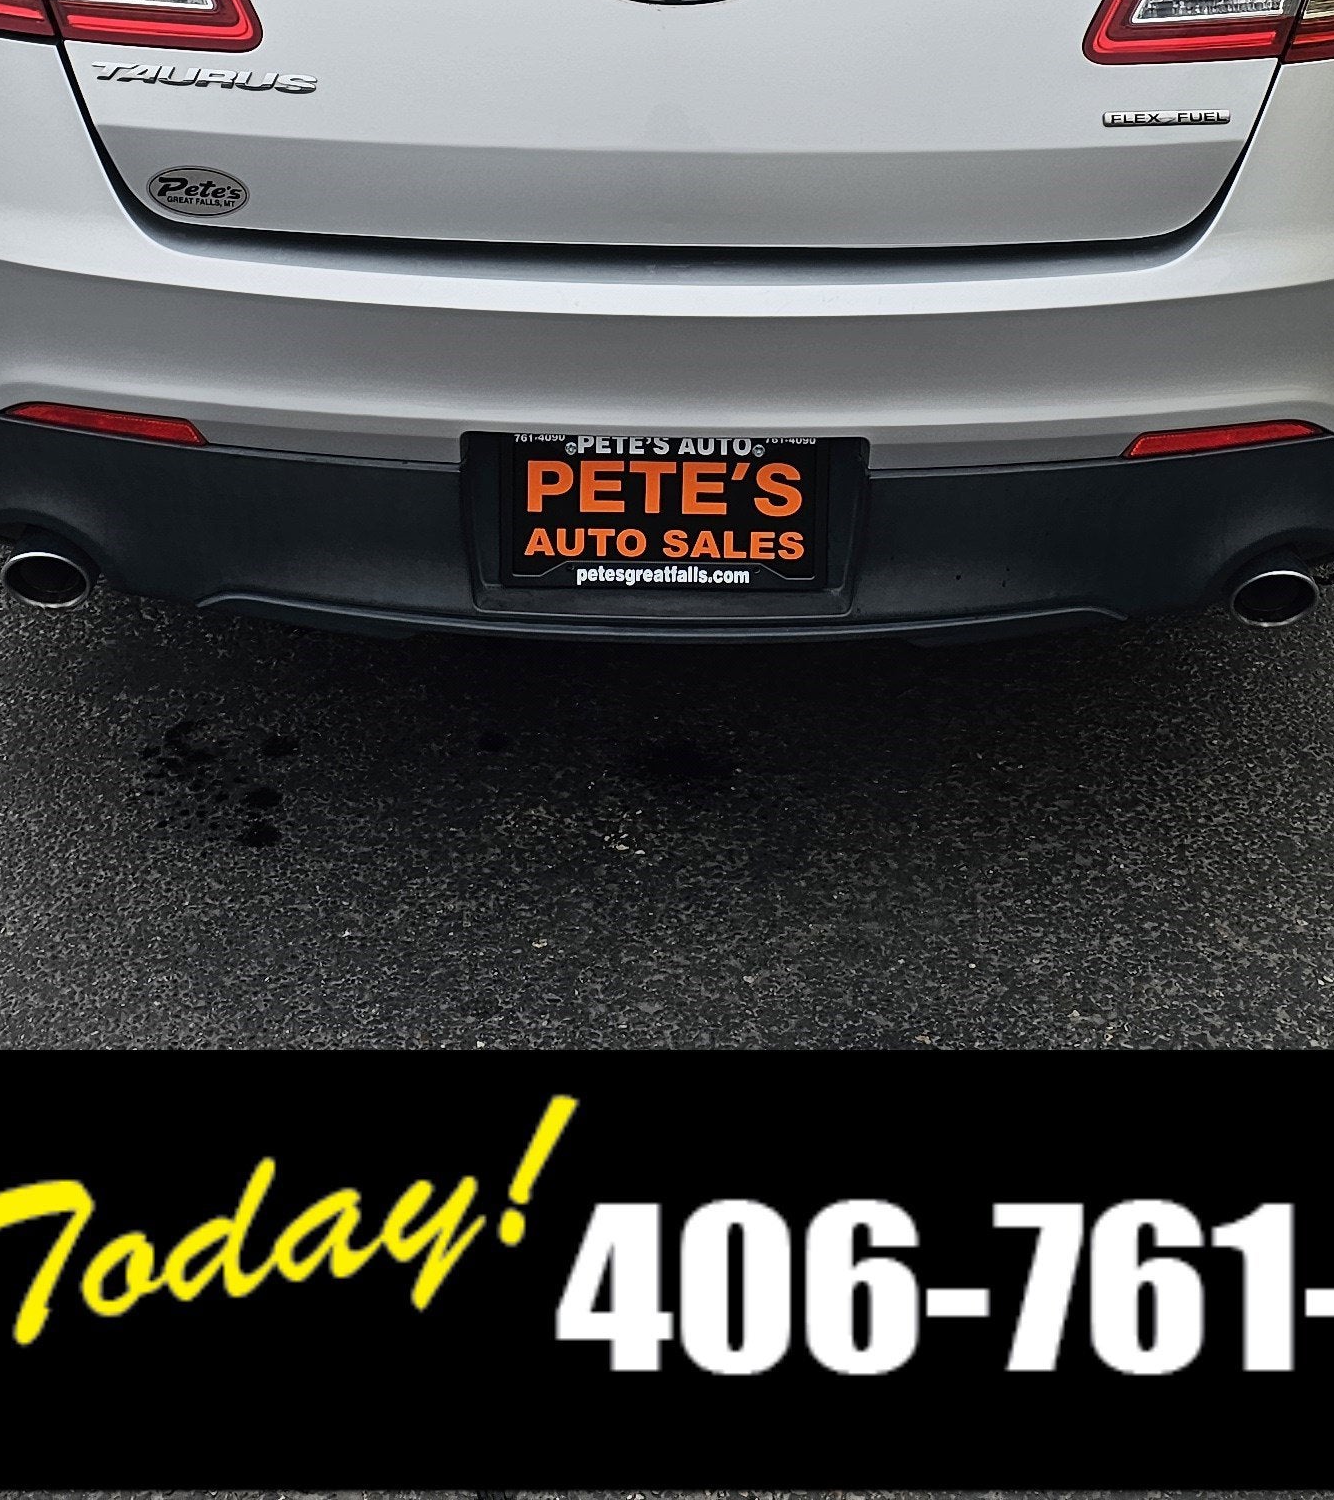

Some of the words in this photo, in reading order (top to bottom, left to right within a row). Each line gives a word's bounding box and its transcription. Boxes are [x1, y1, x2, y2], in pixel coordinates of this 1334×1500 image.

[92, 61, 318, 94] TAURUS
[1110, 113, 1161, 124] FLEX
[1177, 112, 1228, 122] FUEL
[157, 176, 243, 200] Pete's
[167, 195, 194, 205] GREAT
[223, 199, 236, 208] MT
[577, 435, 670, 455] PETE'S
[677, 437, 752, 456] AUTO
[527, 460, 803, 517] PETE'S
[524, 527, 648, 558] AUTO
[662, 529, 805, 560] SALES
[576, 565, 751, 587] petesgreatfalls.com
